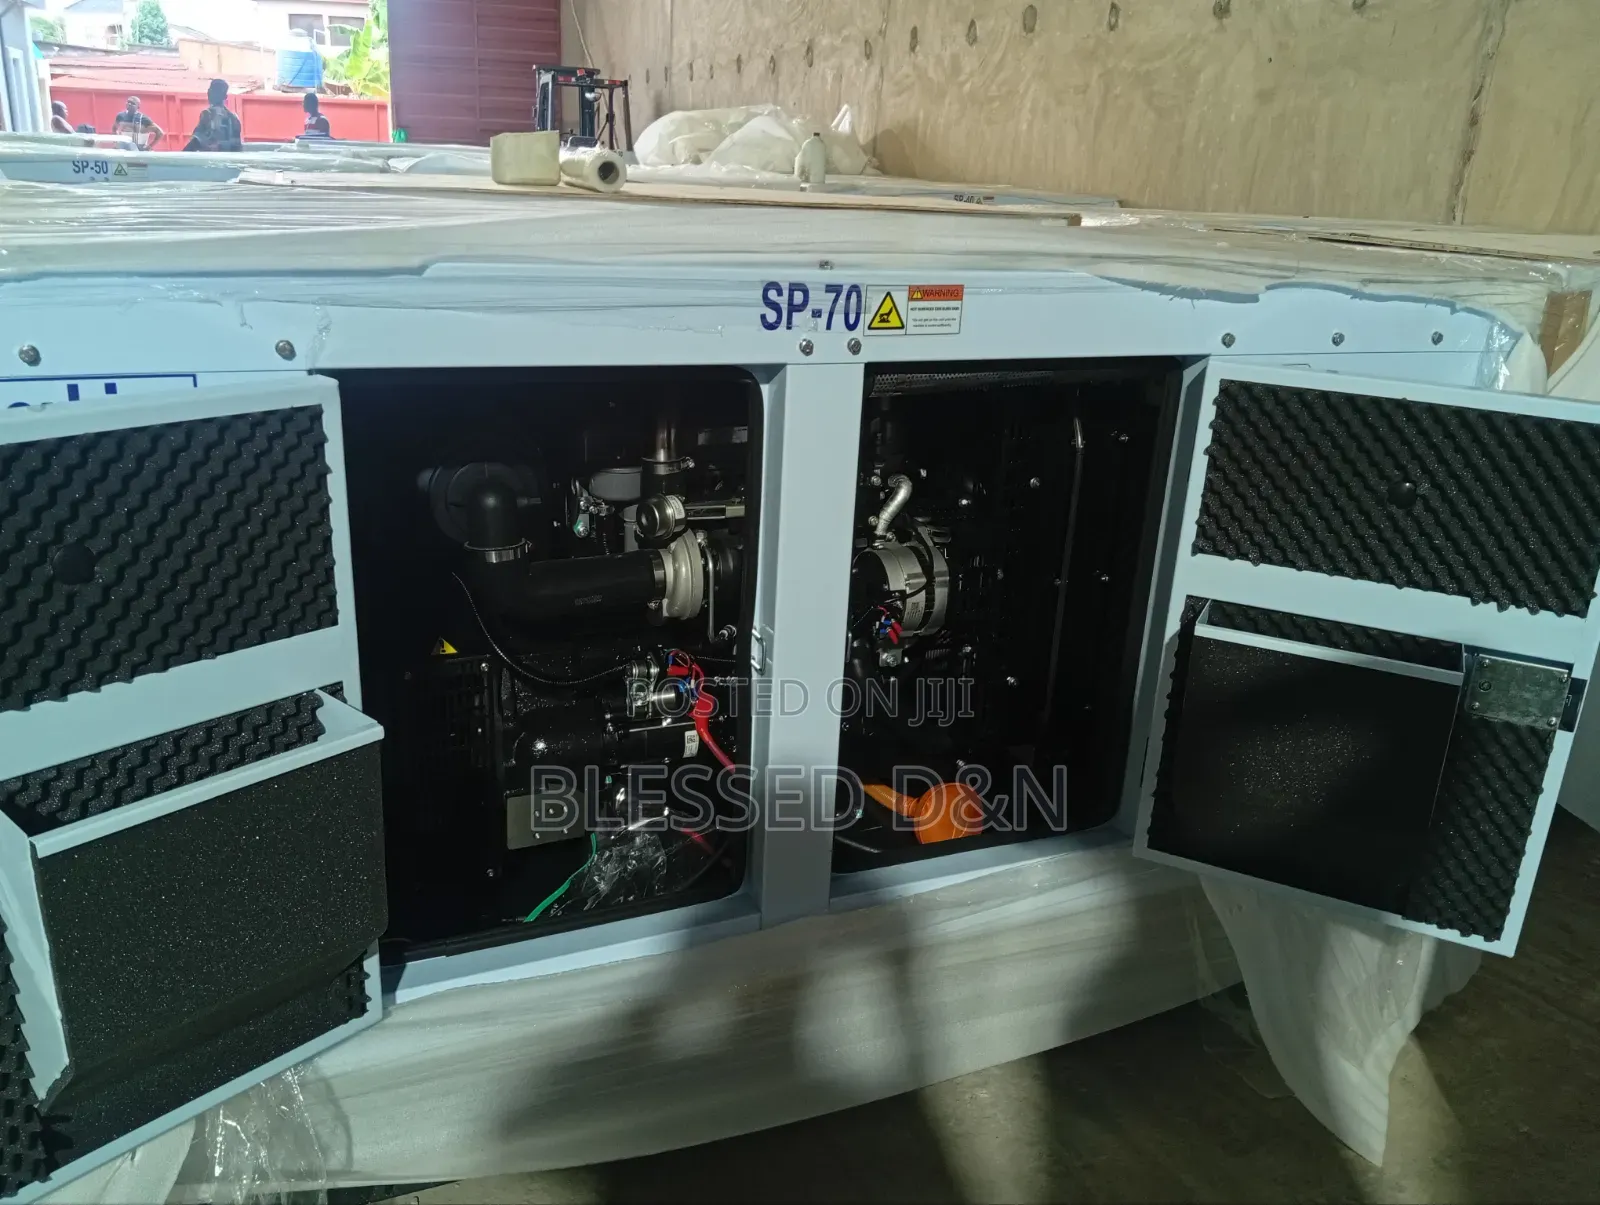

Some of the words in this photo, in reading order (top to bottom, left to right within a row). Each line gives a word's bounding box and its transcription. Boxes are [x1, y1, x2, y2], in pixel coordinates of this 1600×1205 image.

[72, 160, 109, 174] SP-50
[922, 288, 960, 298] WARNING
[760, 281, 863, 332] SP-70
